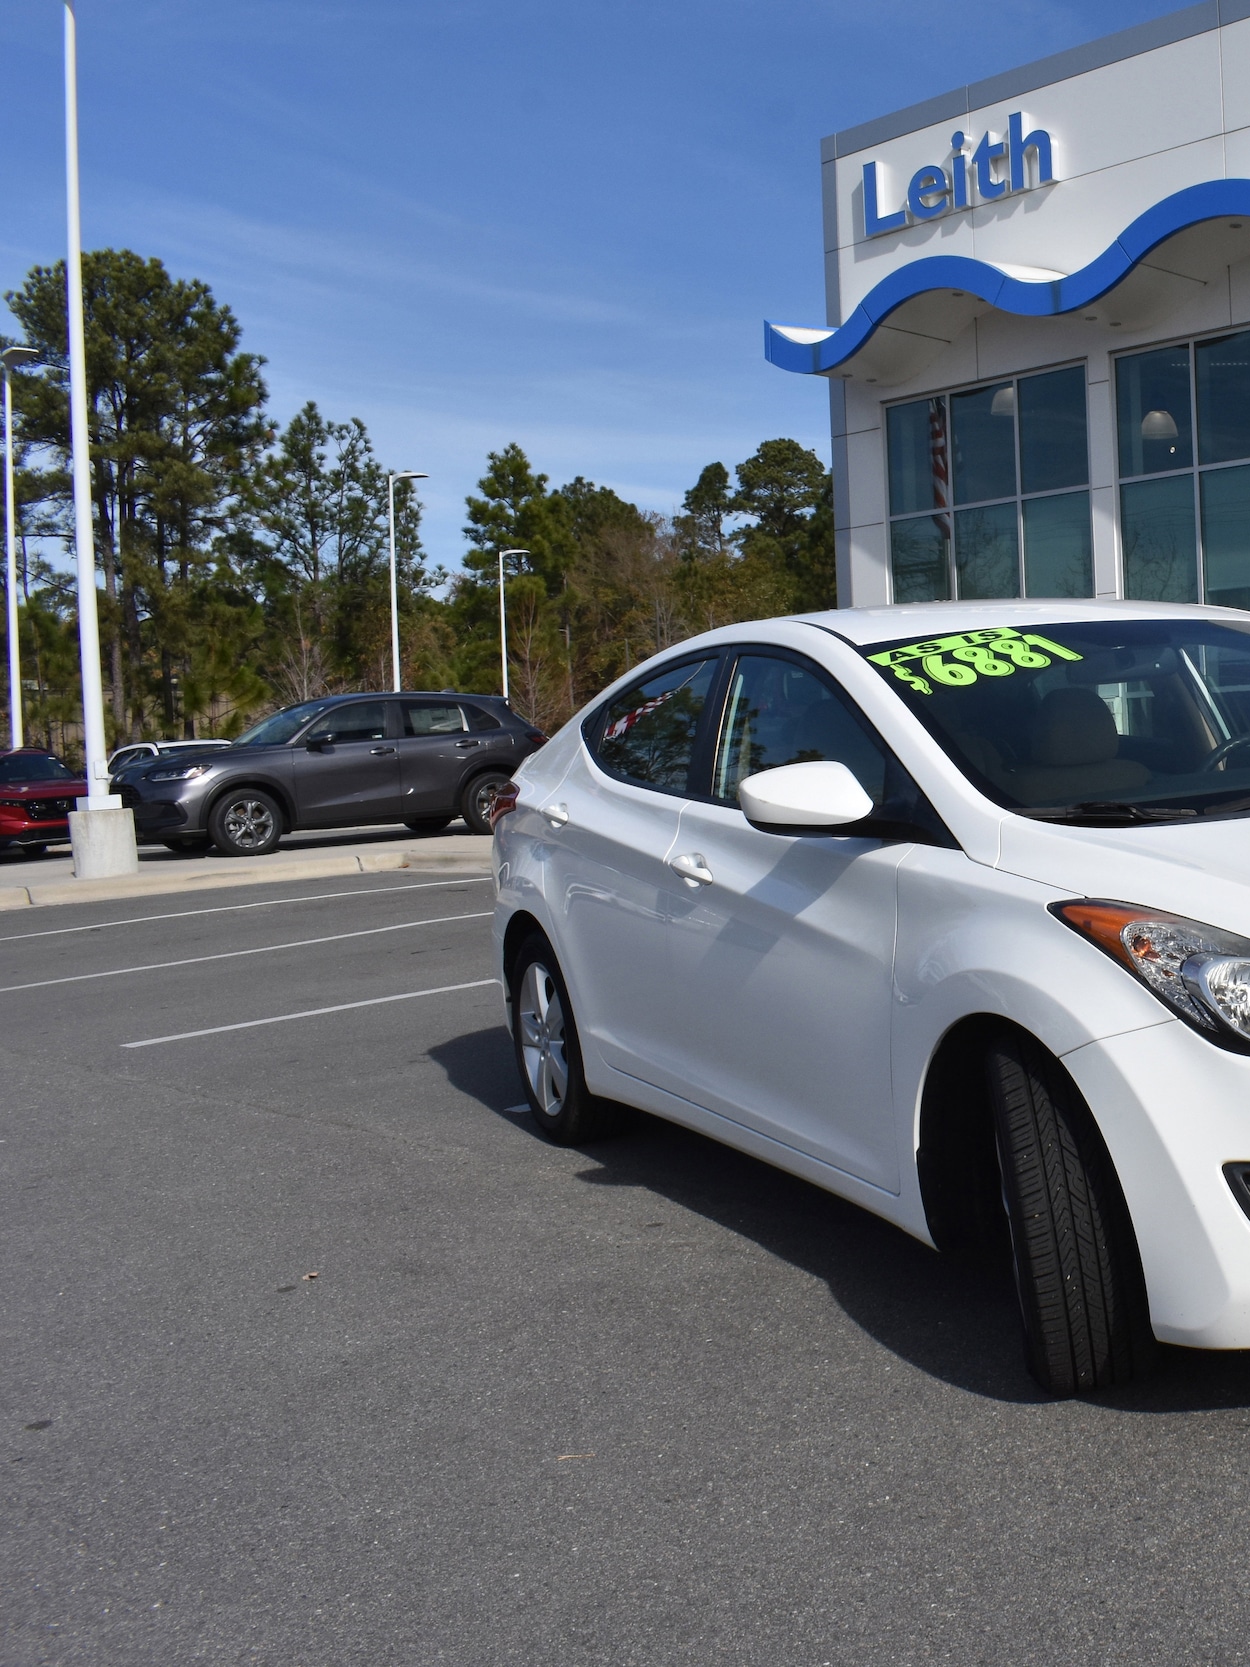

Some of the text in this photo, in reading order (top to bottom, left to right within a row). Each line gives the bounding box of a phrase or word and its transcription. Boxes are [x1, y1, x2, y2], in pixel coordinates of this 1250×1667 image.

[862, 111, 1055, 237] Leith
[889, 630, 1003, 663] AS IS
